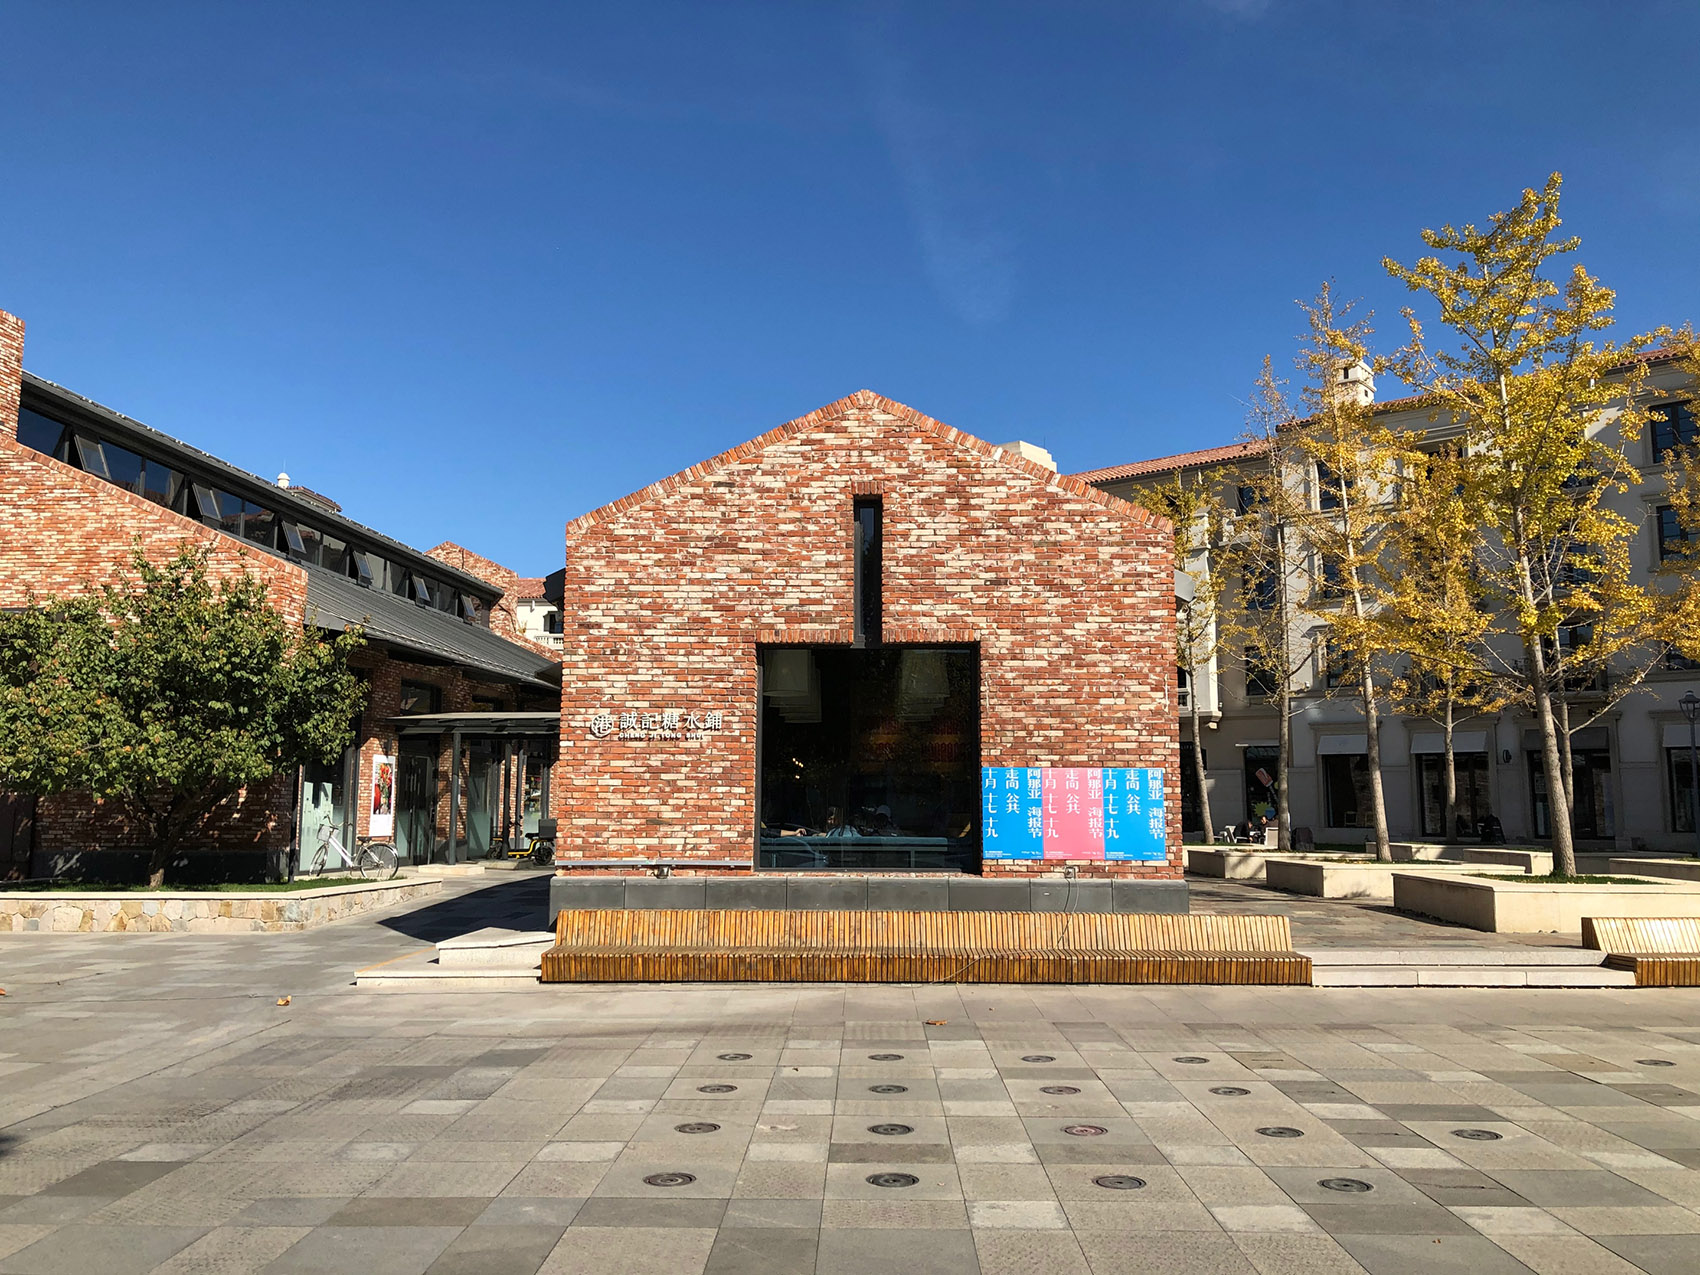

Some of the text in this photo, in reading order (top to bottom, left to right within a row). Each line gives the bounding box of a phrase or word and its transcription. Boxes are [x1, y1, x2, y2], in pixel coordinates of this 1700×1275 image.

[592, 712, 722, 737] 港 誠記糖水鋪
[983, 768, 998, 789] 十月
[1005, 768, 1020, 814] 走向 公共
[1027, 768, 1042, 799] 阿那亚
[1043, 768, 1057, 789] 十月
[1065, 768, 1080, 814] 走向 公共
[1088, 769, 1102, 799] 阿那亚
[1125, 769, 1141, 815] 走向 公共
[1147, 769, 1163, 800] 阿那亚
[984, 792, 998, 814] 十七
[1043, 793, 1058, 814] 十七
[1103, 769, 1119, 839] 十月 十七 十九
[984, 817, 999, 838] 十九
[1027, 806, 1042, 838] 海报节
[1043, 817, 1059, 838] 十九
[1088, 806, 1103, 838] 海报节
[1148, 807, 1164, 839] 海报节
